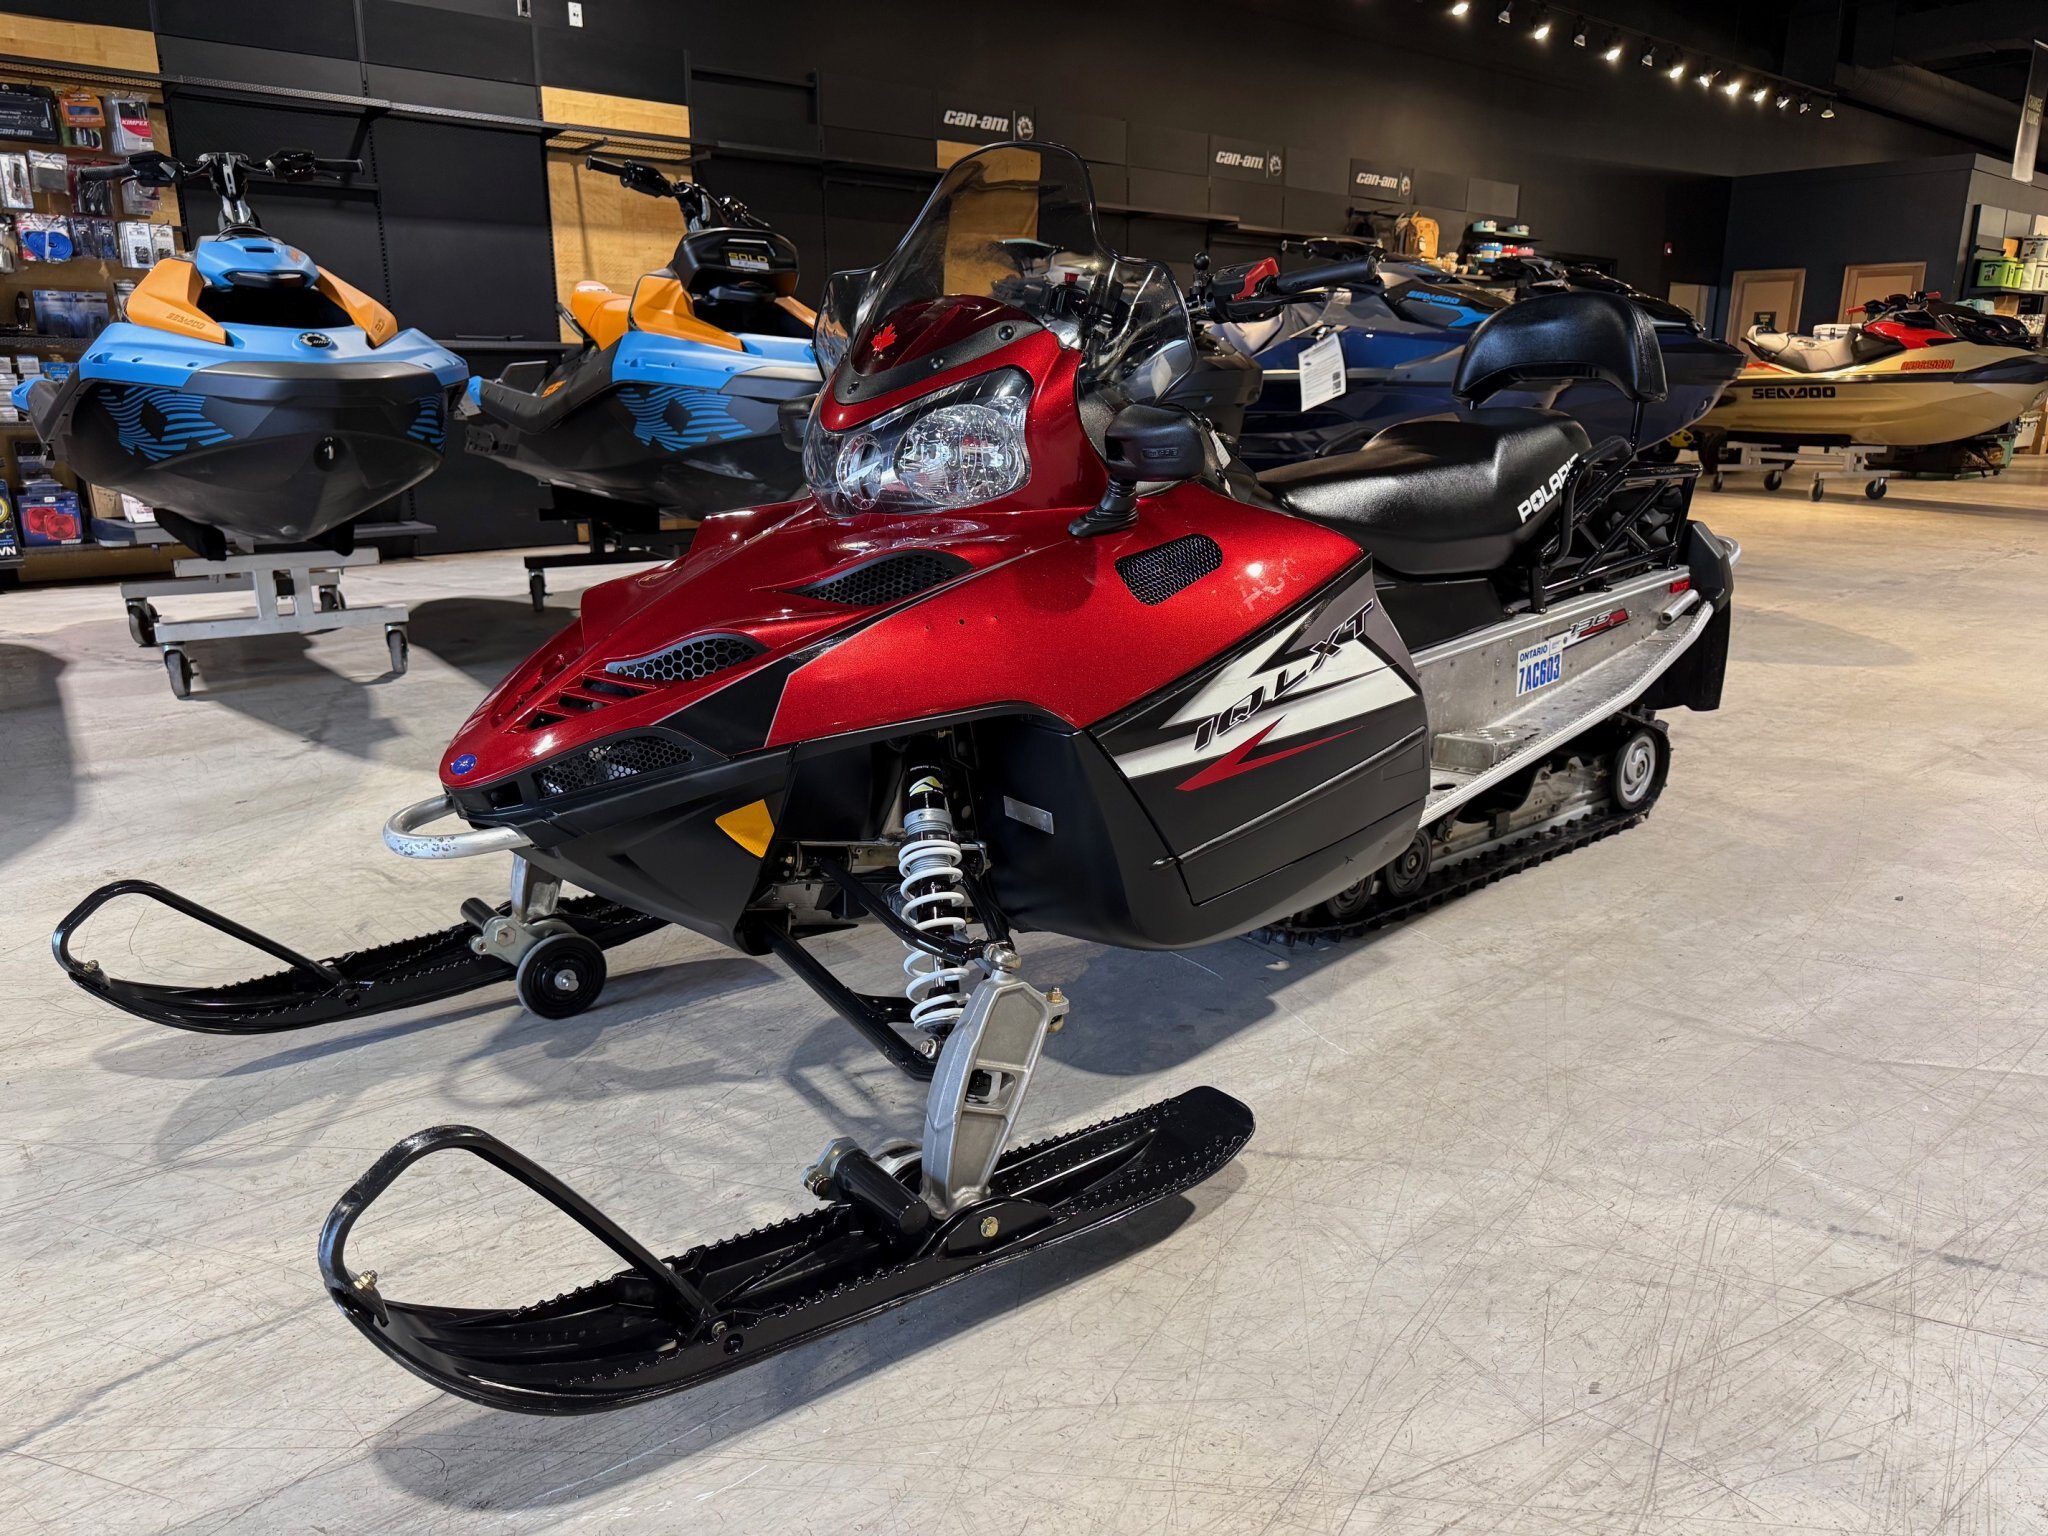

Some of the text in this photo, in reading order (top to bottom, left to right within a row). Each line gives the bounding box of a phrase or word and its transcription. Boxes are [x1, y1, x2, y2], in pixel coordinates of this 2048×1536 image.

[121, 119, 149, 127] KIMPEX
[943, 109, 1008, 132] can-am
[1215, 151, 1264, 169] can-am
[1356, 172, 1398, 189] can-am
[728, 252, 768, 263] SOLD
[1517, 452, 1579, 524] POLAR
[1570, 609, 1613, 636] 136
[1271, 598, 1375, 702] LXT
[1519, 644, 1548, 662] ONTARIO
[1518, 653, 1561, 694] 7AC603
